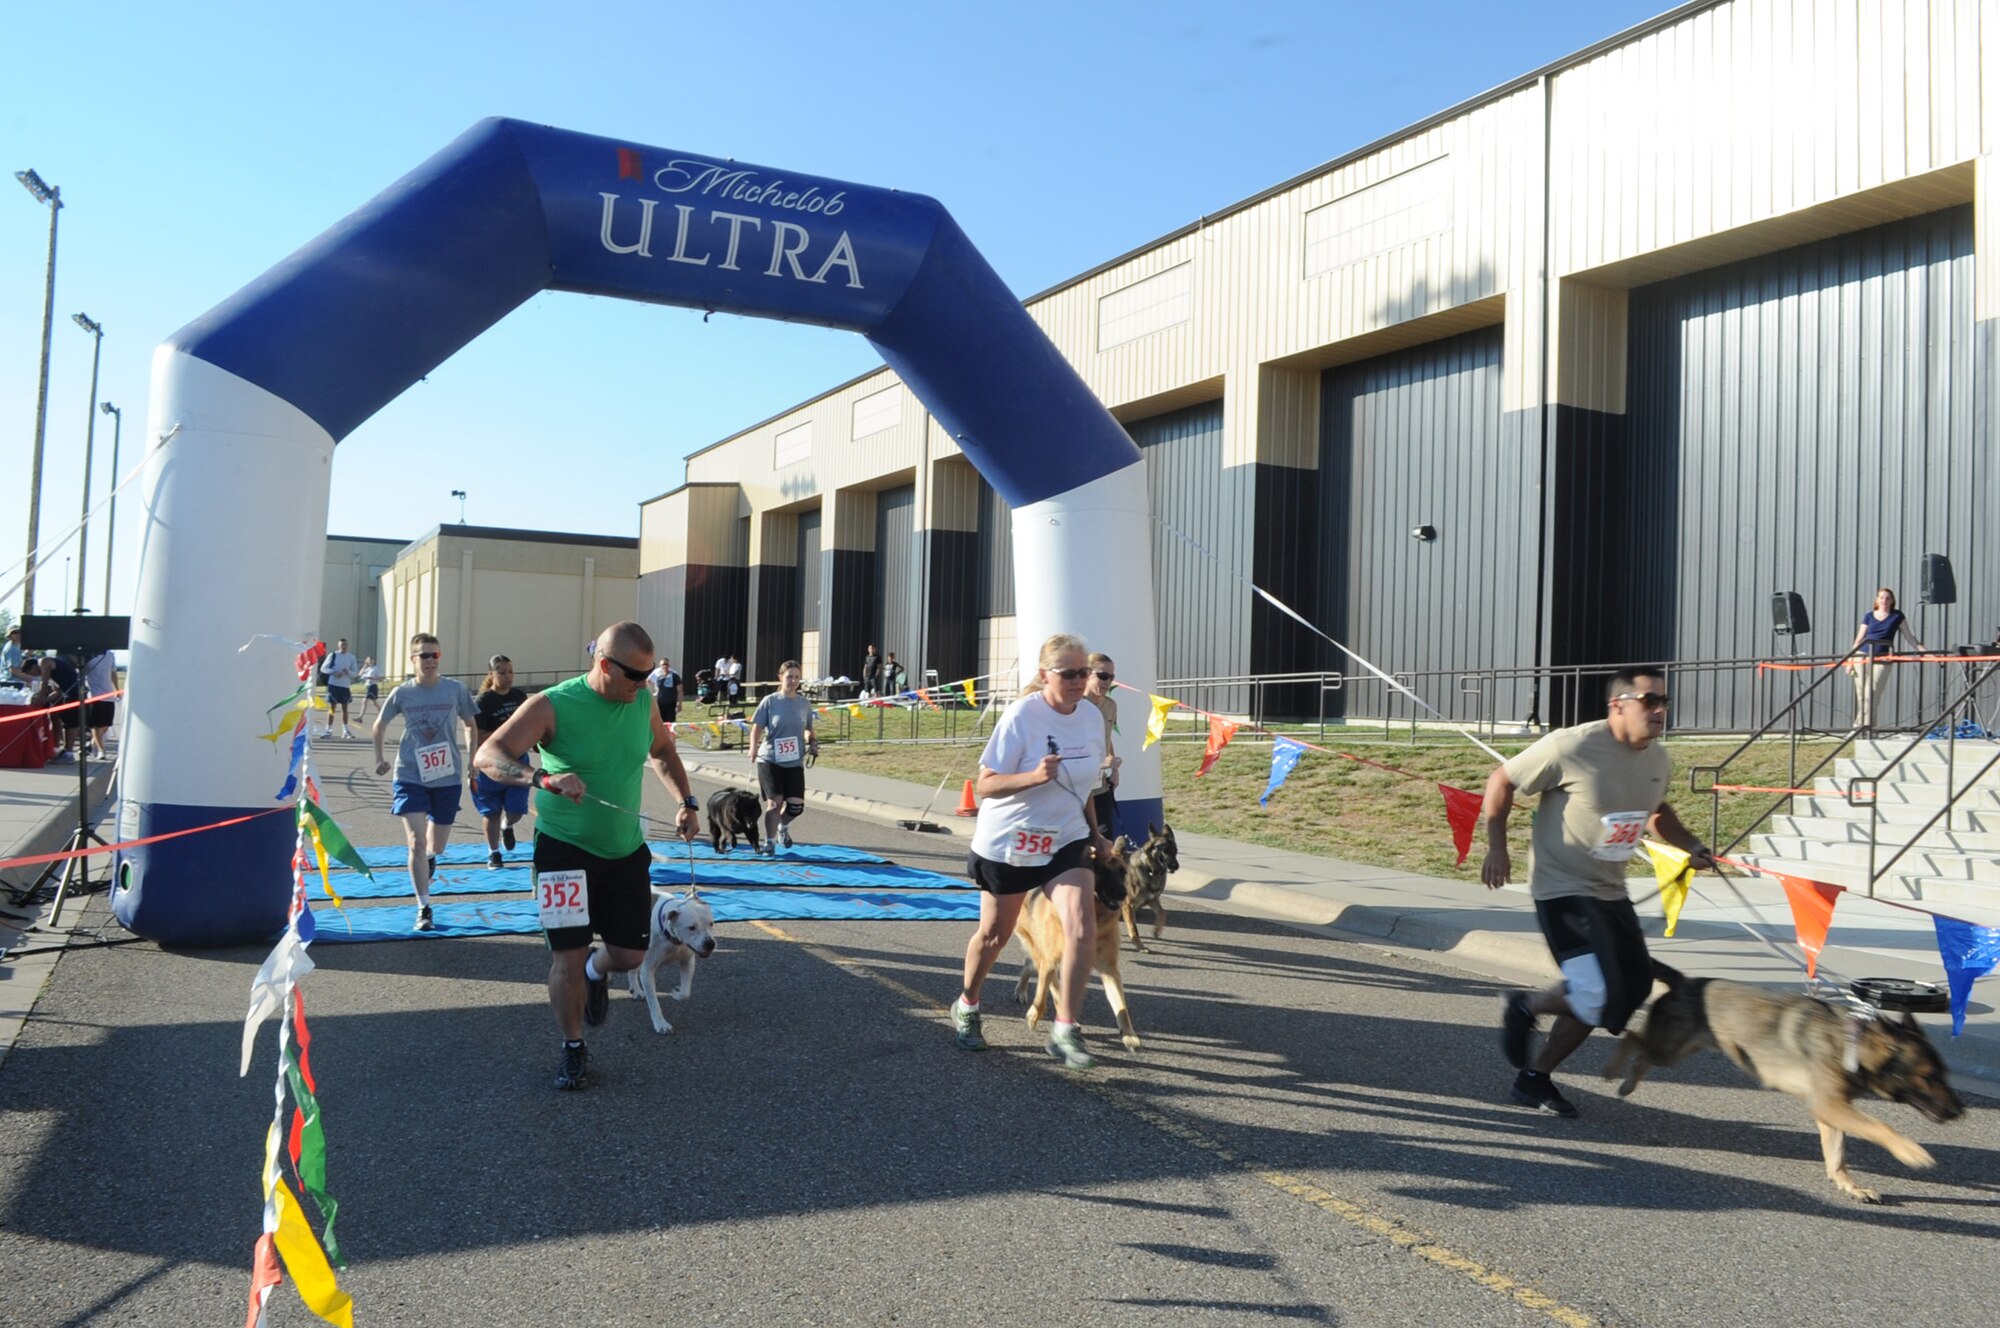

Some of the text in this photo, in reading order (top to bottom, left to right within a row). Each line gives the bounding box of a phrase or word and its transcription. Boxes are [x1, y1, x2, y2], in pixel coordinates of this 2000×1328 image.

[654, 159, 847, 216] Michelob
[598, 192, 864, 289] ULTRA
[421, 749, 446, 770] 367
[778, 742, 795, 754] 355
[1015, 831, 1053, 855] 358
[542, 881, 581, 909] 352
